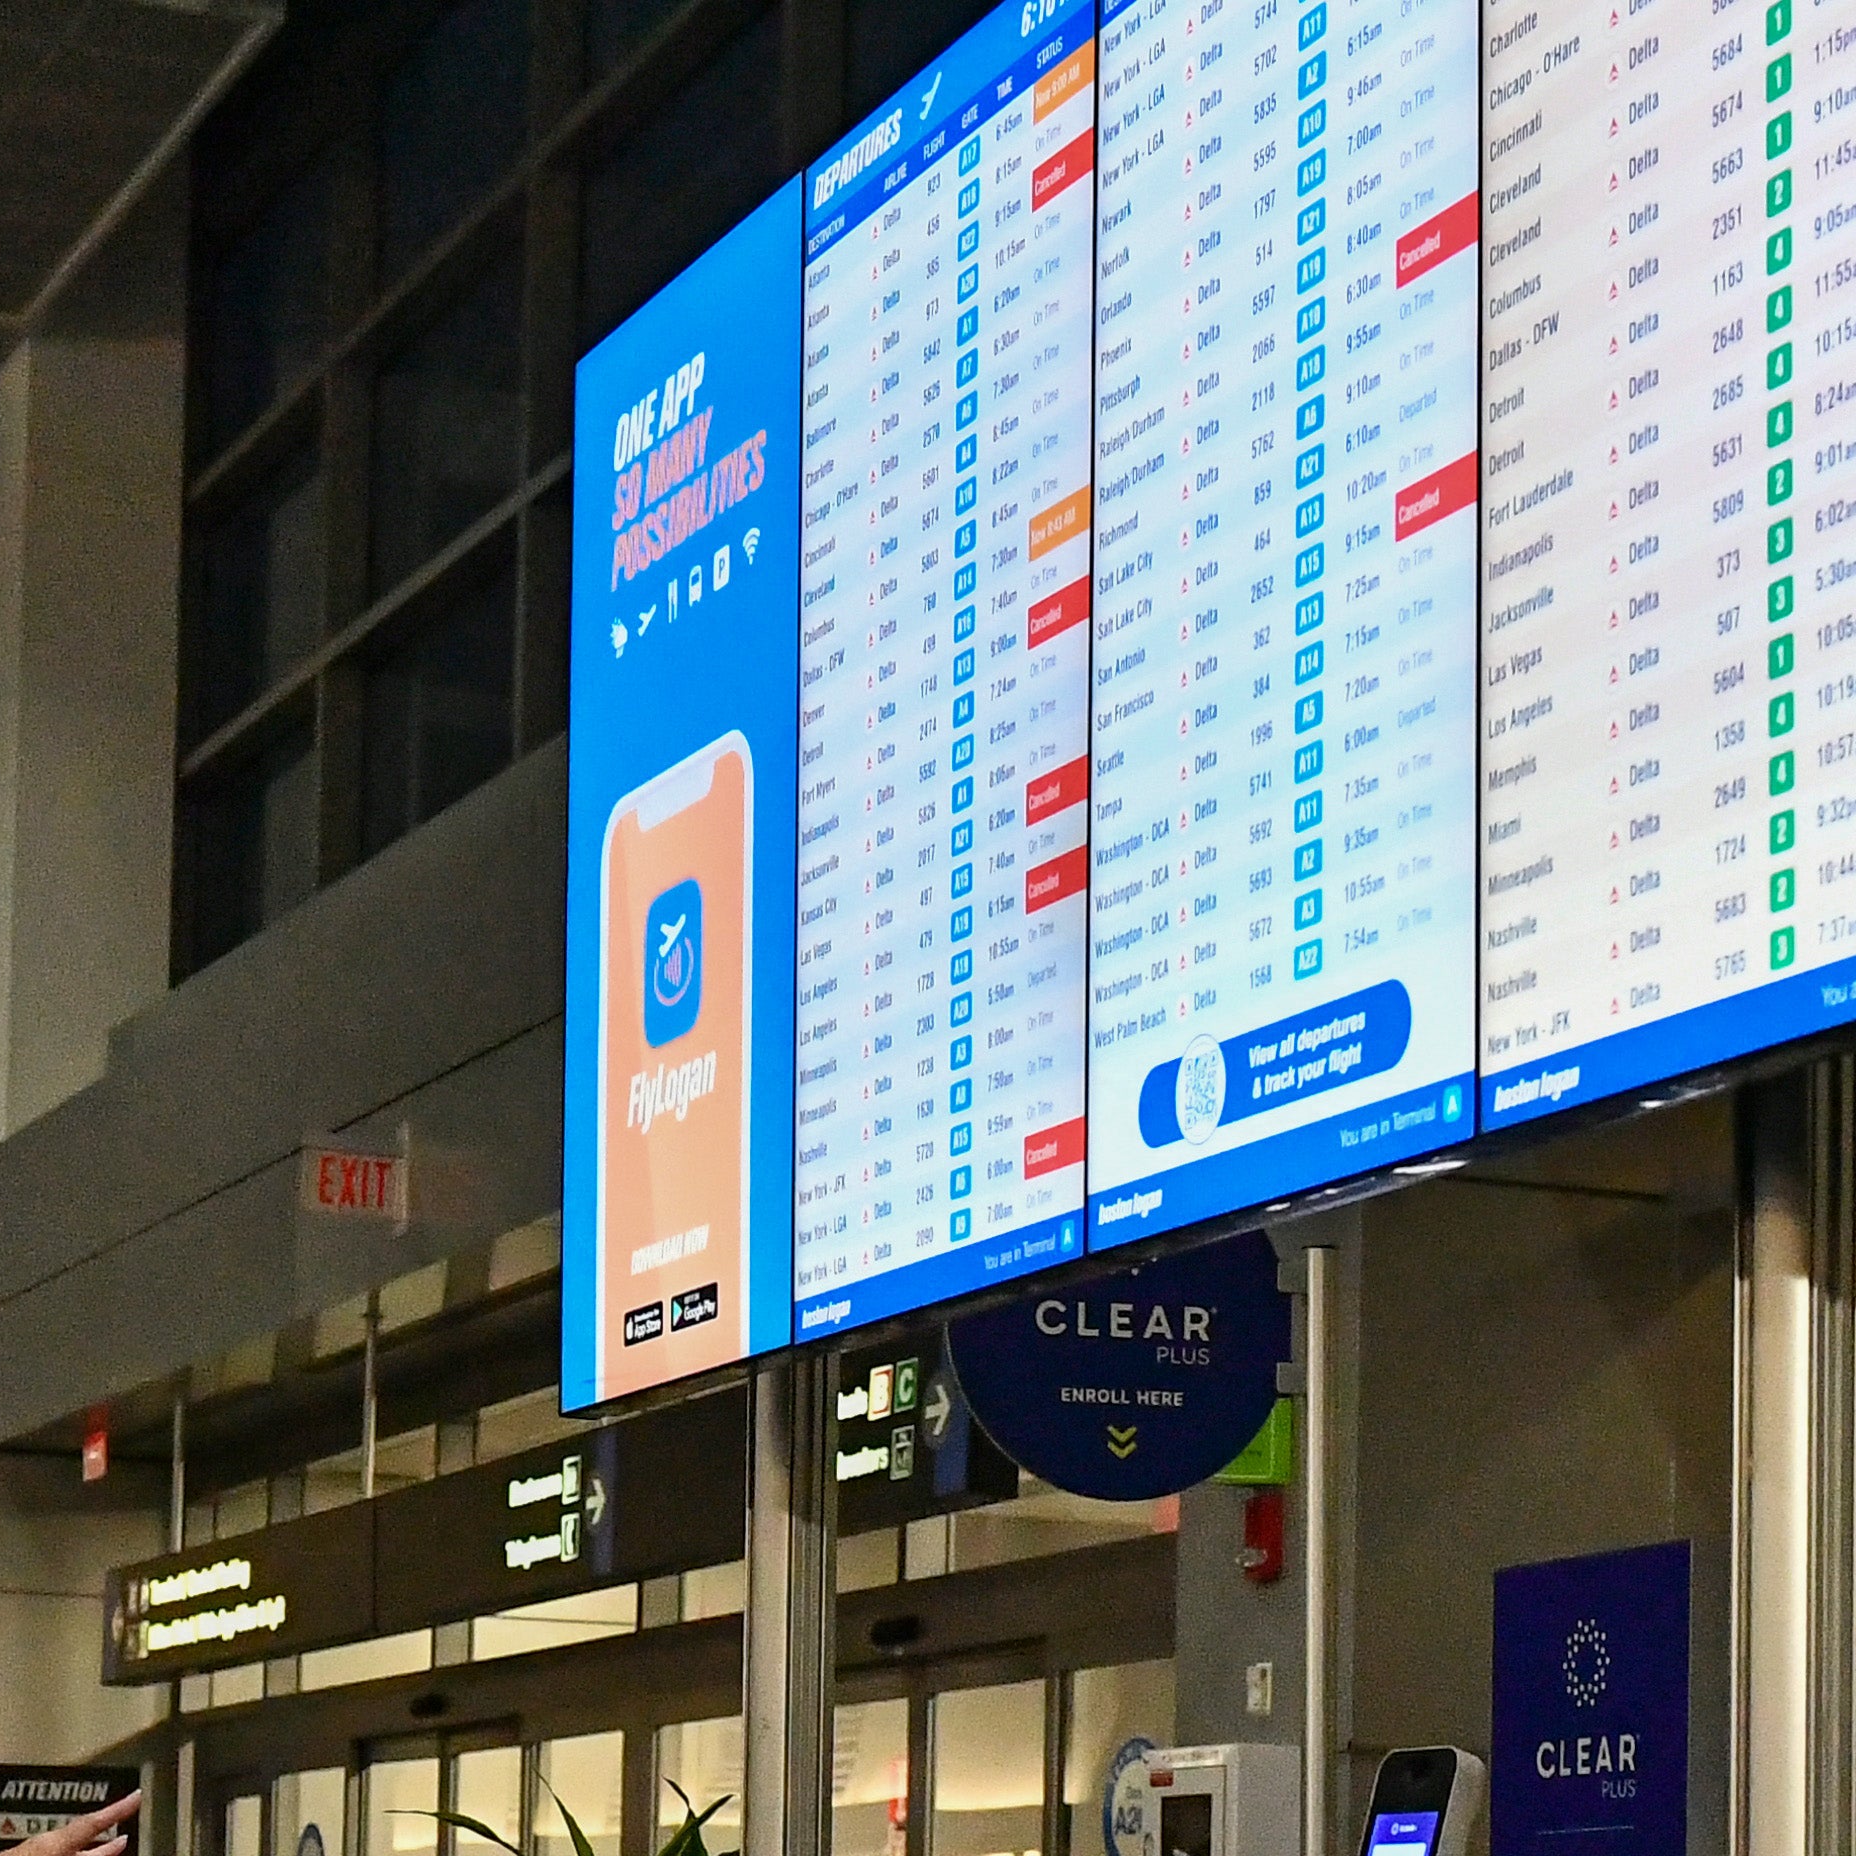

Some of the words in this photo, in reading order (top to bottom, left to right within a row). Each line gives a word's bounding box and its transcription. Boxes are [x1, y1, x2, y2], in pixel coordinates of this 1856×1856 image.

[1036, 36, 1063, 69] STATUS
[1348, 22, 1382, 57] 6:15am
[1490, 12, 1537, 58] Charlotte
[1712, 32, 1742, 71] 5684
[1254, 44, 1277, 76] 5702
[997, 76, 1013, 100] TIME
[961, 104, 978, 129] GATE
[1712, 89, 1743, 128] 5674
[923, 131, 946, 160] FLIGHT
[1490, 109, 1542, 162] Cincinnati
[813, 108, 902, 210] DEPARTURES
[962, 148, 977, 171] A17
[1712, 147, 1743, 184] 5663
[1034, 161, 1066, 197] Cancelled
[1347, 173, 1381, 206] 8:05am
[1490, 162, 1541, 214] Cleveland
[1102, 198, 1131, 235] Newark
[1254, 188, 1276, 220] 1797
[1629, 203, 1659, 235] Delta
[1712, 203, 1741, 240] 2351
[1102, 246, 1129, 280] Norfolk
[1256, 238, 1272, 266] 514
[1399, 230, 1441, 271] Cancelled
[1490, 274, 1541, 319] Columbus
[1713, 260, 1743, 296] 1163
[1253, 333, 1275, 364] 2066
[1347, 323, 1381, 354] 9:55am
[614, 388, 657, 472] ONE
[658, 351, 705, 438] APP
[1489, 387, 1524, 424] Detroit
[1346, 424, 1380, 453] 6:10am
[612, 462, 641, 530] SO
[644, 405, 713, 508] MANY
[611, 429, 766, 592] POSSIBILITIES
[1489, 501, 1510, 529] Fort
[1513, 468, 1573, 516] Lauderdale
[1717, 548, 1740, 579] 373
[1489, 585, 1554, 634] Jacksonville
[1096, 666, 1112, 686] San
[1115, 647, 1145, 677] Antonio
[802, 787, 814, 806] Fort
[817, 777, 835, 799] Myers
[1821, 984, 1848, 1008] You
[1248, 1044, 1277, 1069] View
[1279, 1033, 1296, 1058] all
[1297, 1011, 1366, 1053] departures
[1264, 1063, 1296, 1094] track
[1296, 1058, 1327, 1090] your
[1327, 1041, 1362, 1076] flight
[627, 1051, 717, 1135] FlyLogan
[1494, 1073, 1541, 1113] boston
[1539, 1065, 1580, 1102] logan
[1339, 1128, 1359, 1149] You
[1360, 1123, 1379, 1142] are
[1380, 1119, 1391, 1135] in
[1392, 1101, 1437, 1133] Terminal
[1446, 1093, 1459, 1116] A
[319, 1156, 392, 1208] EXIT
[1098, 1194, 1133, 1226] boston
[1132, 1188, 1162, 1218] logan
[1035, 1299, 1210, 1342] CLEAR
[1156, 1346, 1210, 1365] PLUS
[899, 1367, 914, 1403] C
[1061, 1387, 1130, 1405] ENROLL
[1136, 1390, 1184, 1407] HERE
[1536, 1733, 1636, 1779] CLEAR
[1, 1780, 109, 1803] ATTENTION
[1602, 1779, 1637, 1799] PLUS
